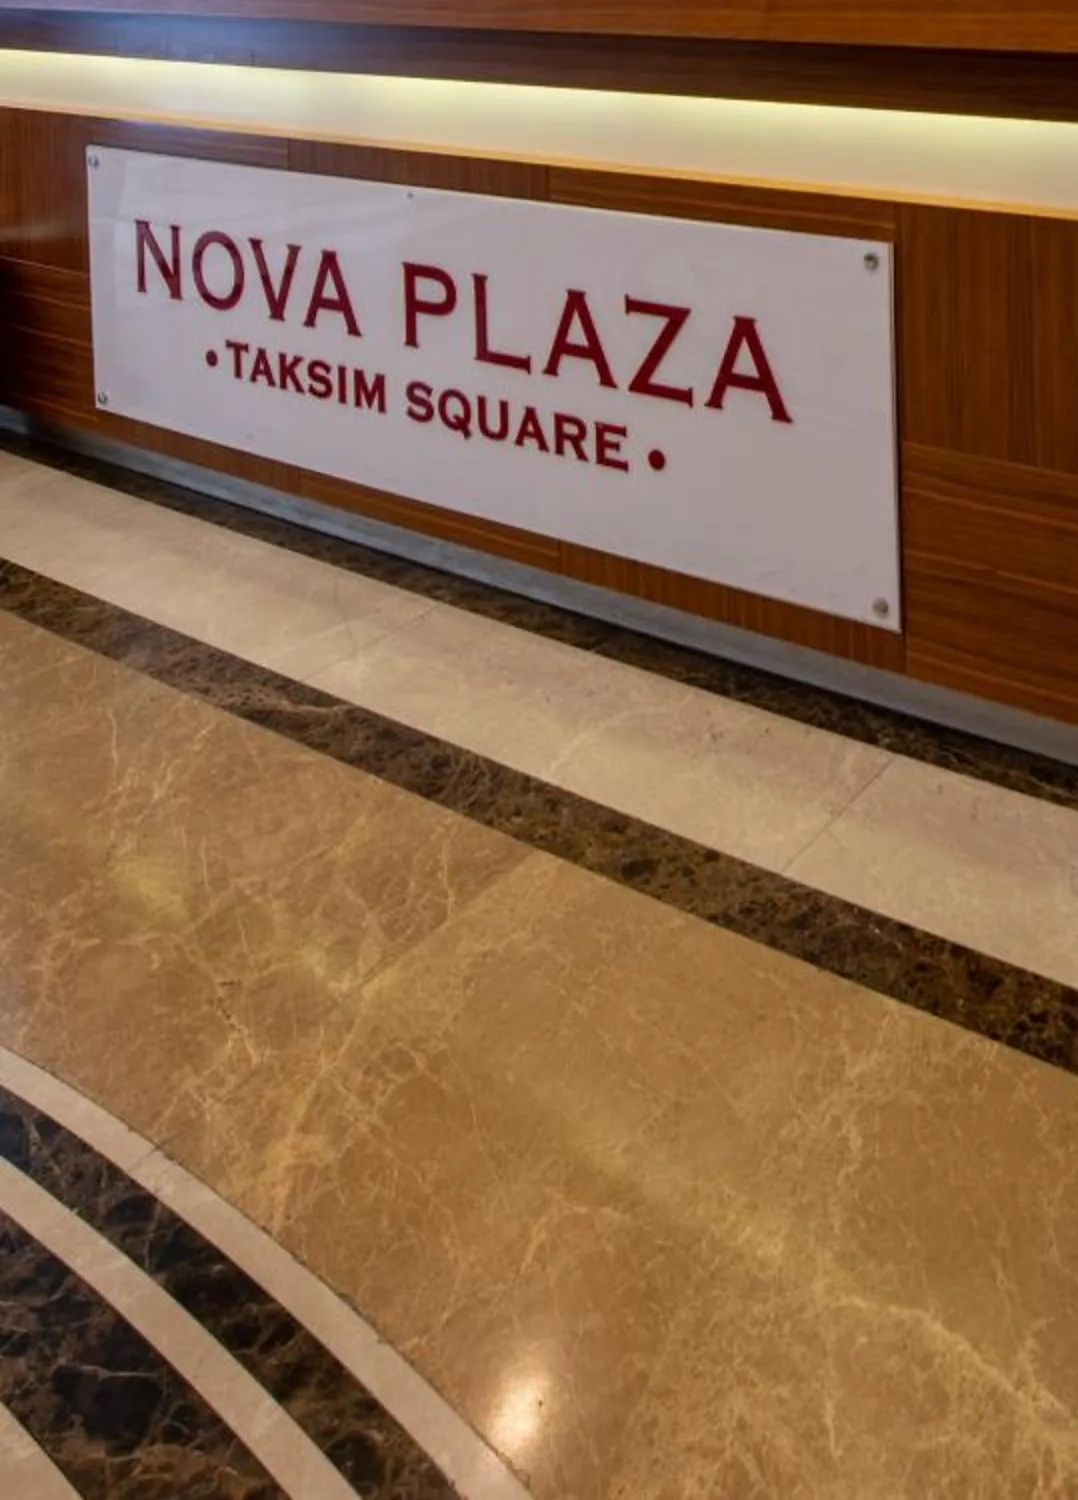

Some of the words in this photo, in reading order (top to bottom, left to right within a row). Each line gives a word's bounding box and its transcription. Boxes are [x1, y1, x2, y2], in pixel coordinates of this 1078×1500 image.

[133, 219, 362, 338] NOVA
[400, 261, 795, 424] PLAZA
[225, 339, 388, 415] TAKSIM
[406, 381, 630, 473] SQUARE
